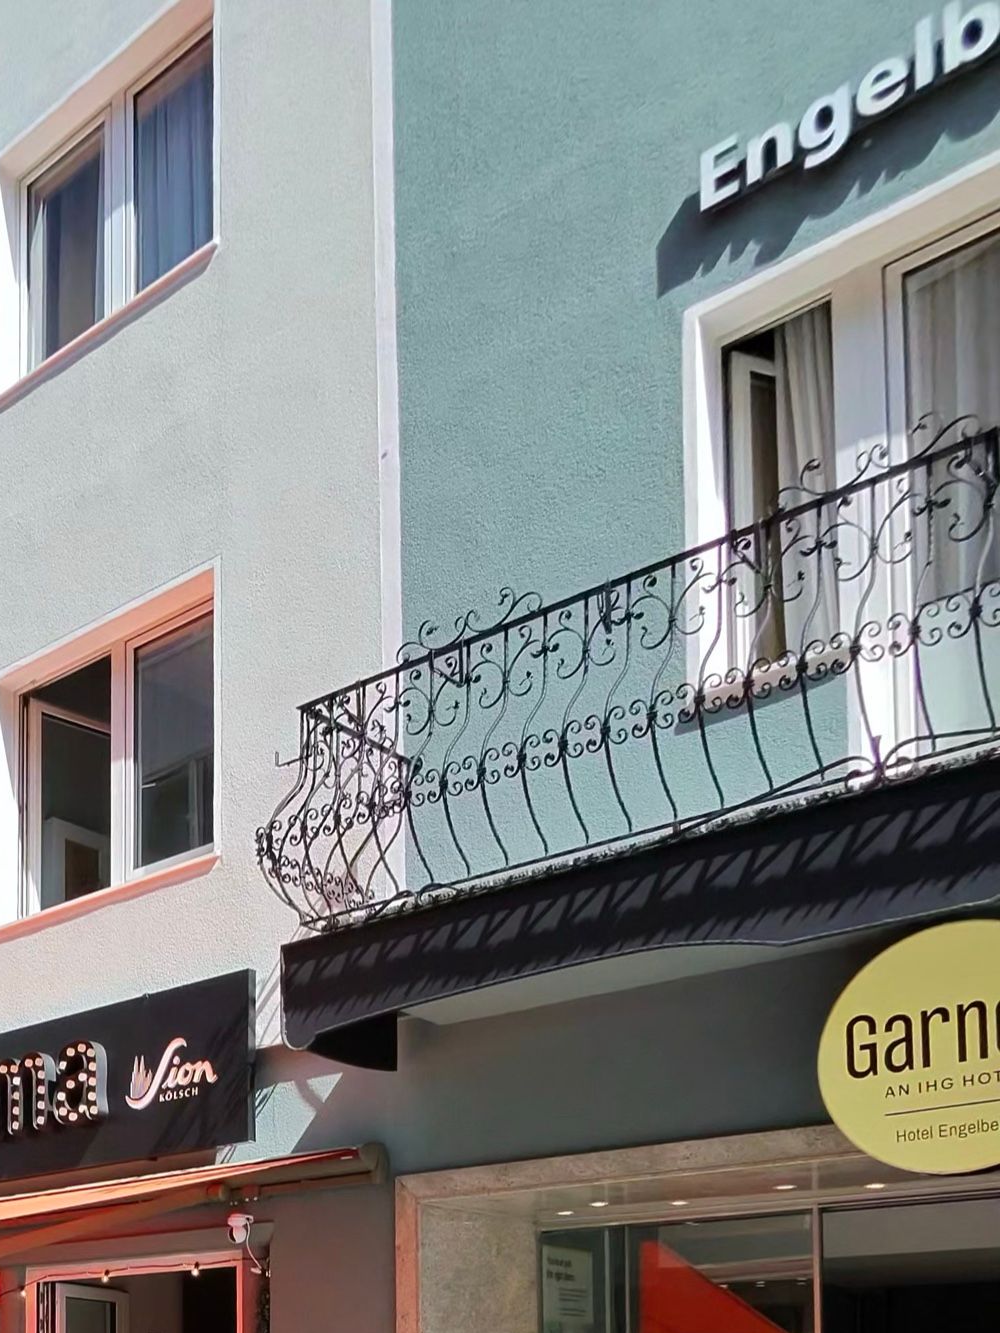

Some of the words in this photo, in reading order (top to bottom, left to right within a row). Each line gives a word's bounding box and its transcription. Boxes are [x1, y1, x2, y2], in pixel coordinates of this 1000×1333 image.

[845, 1000, 1000, 1079] Garn
[125, 1037, 219, 1110] Sion
[159, 1087, 199, 1103] KÖLSCH
[885, 1084, 910, 1098] AN
[918, 1077, 954, 1094] IHG
[896, 1125, 933, 1143] Hotel
